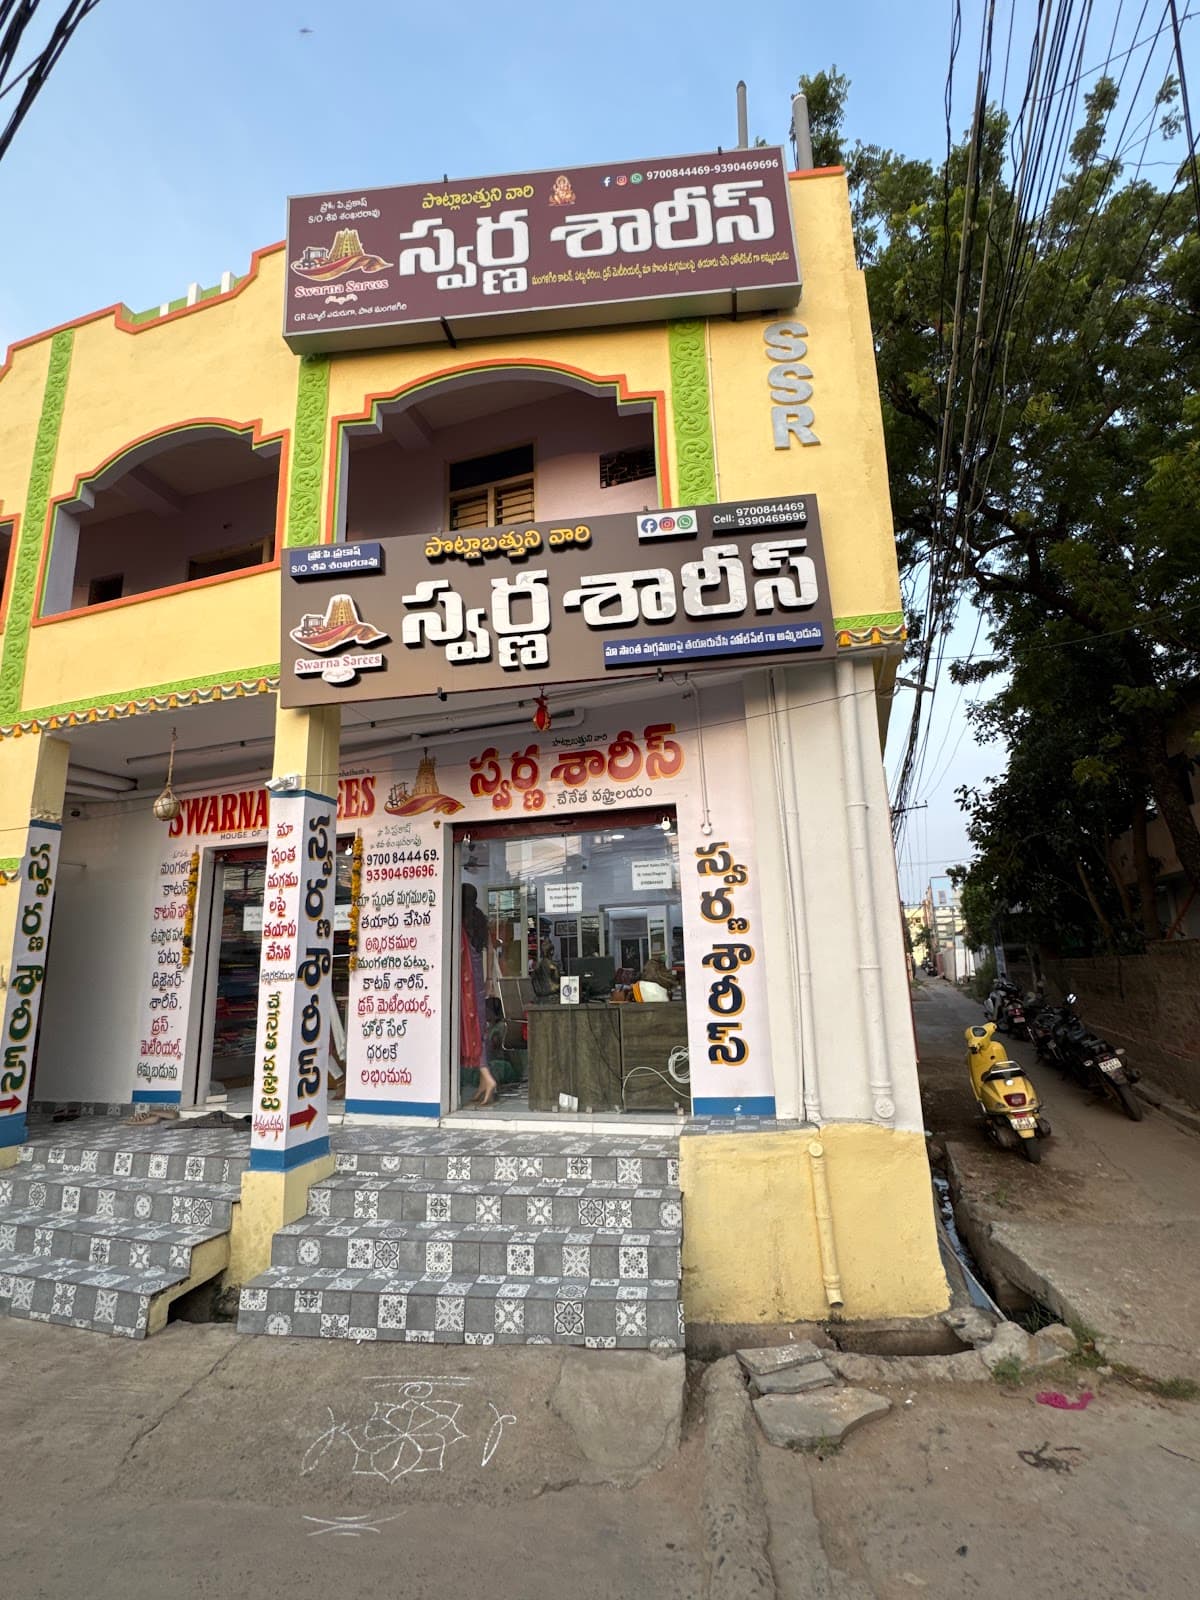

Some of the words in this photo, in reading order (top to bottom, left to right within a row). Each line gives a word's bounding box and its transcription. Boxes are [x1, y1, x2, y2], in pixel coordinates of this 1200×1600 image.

[646, 159, 779, 181] 9700844469-9390469696
[506, 184, 534, 201] వారి
[308, 214, 323, 223] S/O
[399, 208, 529, 295] స్వర్ణ
[550, 180, 775, 258] శారీస్
[294, 284, 344, 298] Swarna
[346, 279, 389, 292] Sarees
[294, 313, 306, 321] GR
[736, 502, 804, 516] 9700844469
[713, 514, 734, 524] Cell:
[738, 512, 806, 526] 9390469696
[425, 530, 541, 558] పొట్లాబత్తుని
[549, 525, 591, 545] వారి
[291, 565, 307, 573] S/O
[402, 569, 550, 668] స్వర్ణ
[563, 538, 819, 626] శారీస్
[605, 646, 617, 657] మా
[296, 658, 340, 671] Swarna
[342, 654, 381, 667] Sarees
[469, 744, 546, 811] స్వర్ణ
[551, 723, 684, 787] శారీస్
[557, 791, 588, 805] చేనేత
[220, 832, 247, 840] HOUSE
[277, 824, 293, 838] మా
[263, 921, 297, 938] తయారు
[361, 914, 399, 929] తయారు
[363, 973, 391, 990] కాటన్
